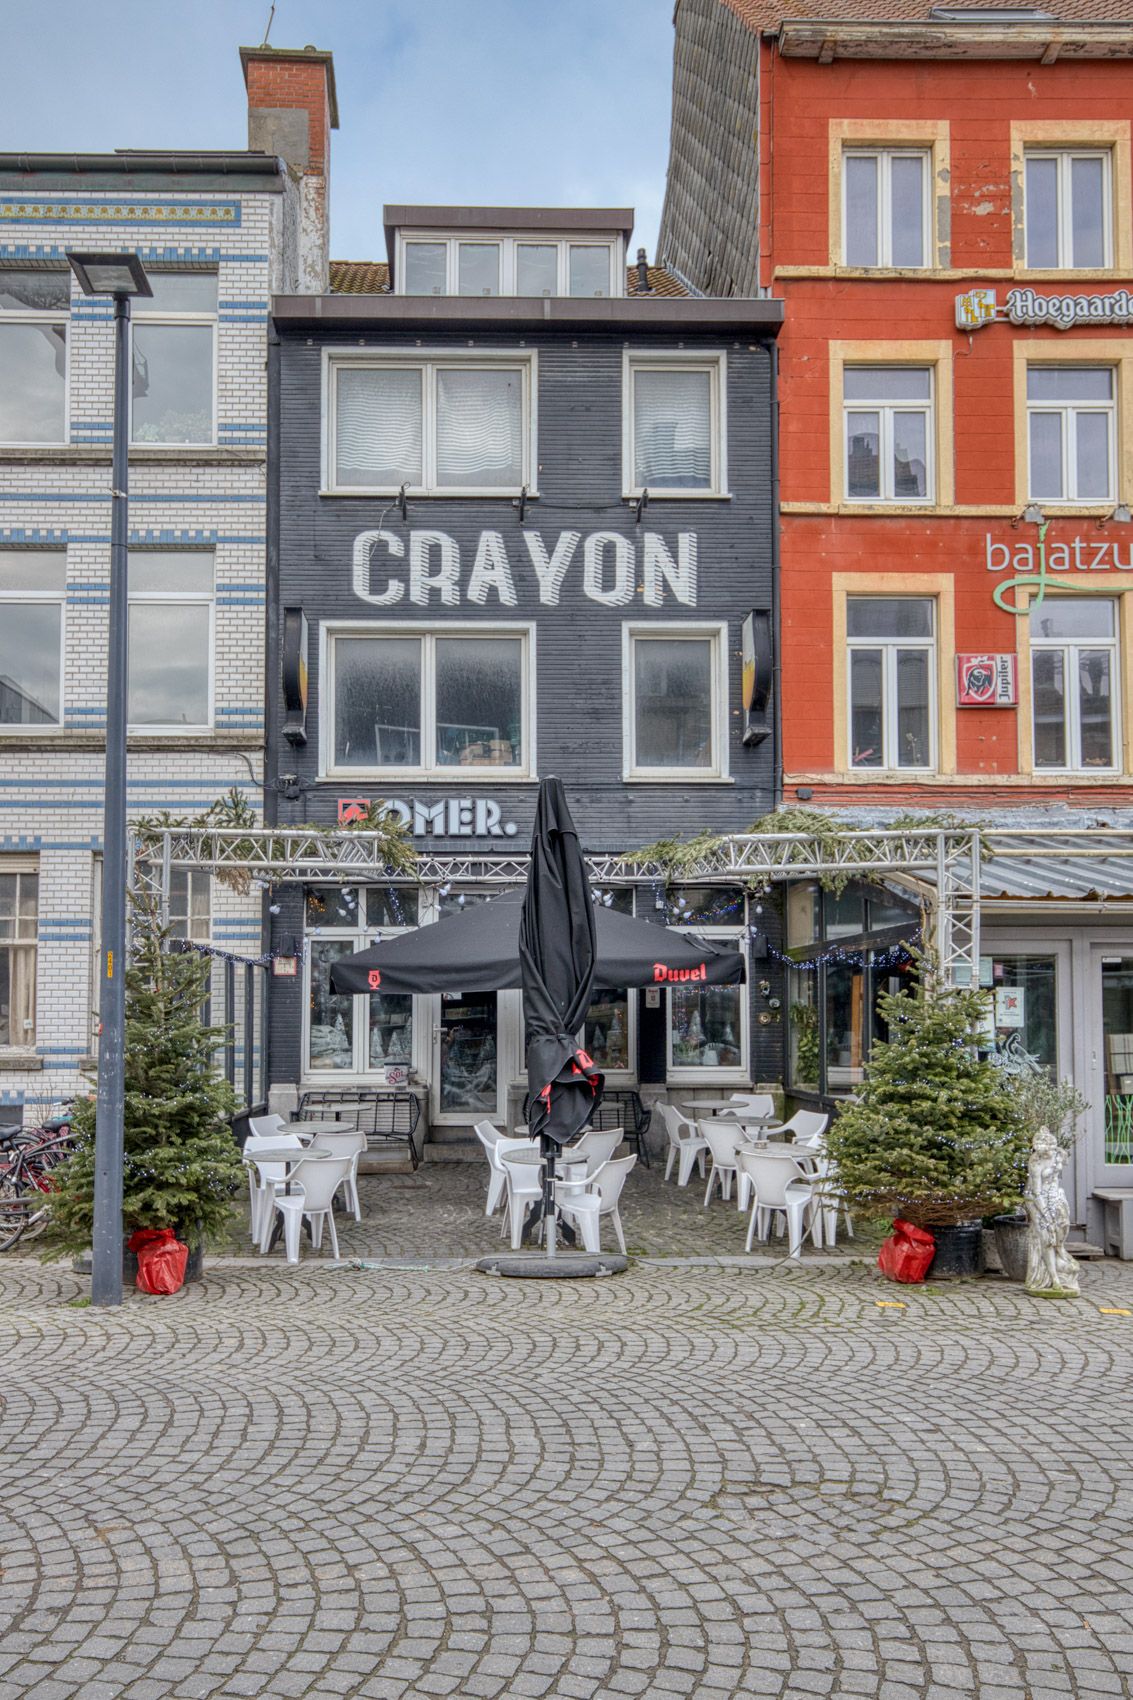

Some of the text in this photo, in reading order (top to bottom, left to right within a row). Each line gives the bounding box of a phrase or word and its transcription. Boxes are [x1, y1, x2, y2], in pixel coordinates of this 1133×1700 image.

[352, 530, 697, 606] CRAYON
[998, 656, 1011, 701] Jupiler
[653, 962, 707, 982] Duvel
